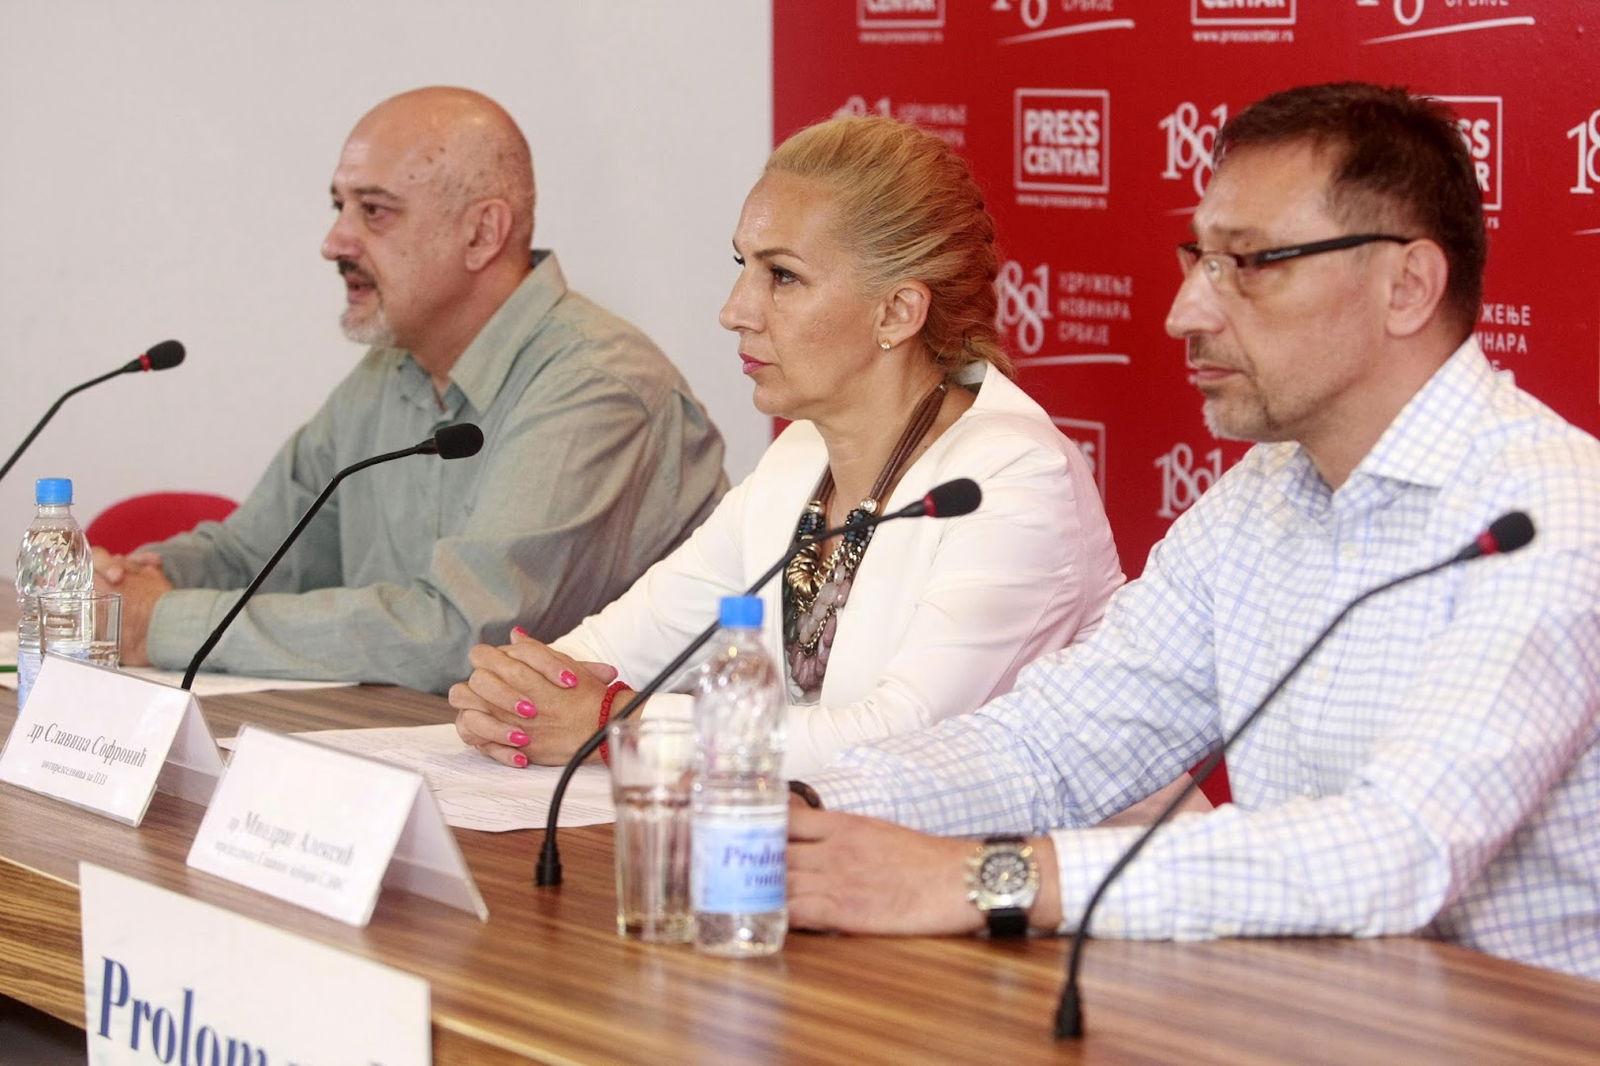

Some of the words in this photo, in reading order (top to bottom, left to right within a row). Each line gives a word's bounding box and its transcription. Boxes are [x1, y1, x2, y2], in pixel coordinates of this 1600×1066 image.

[1024, 109, 1099, 146] PRESS
[1023, 146, 1099, 176] CENTAR
[91, 735, 147, 768] Софронић
